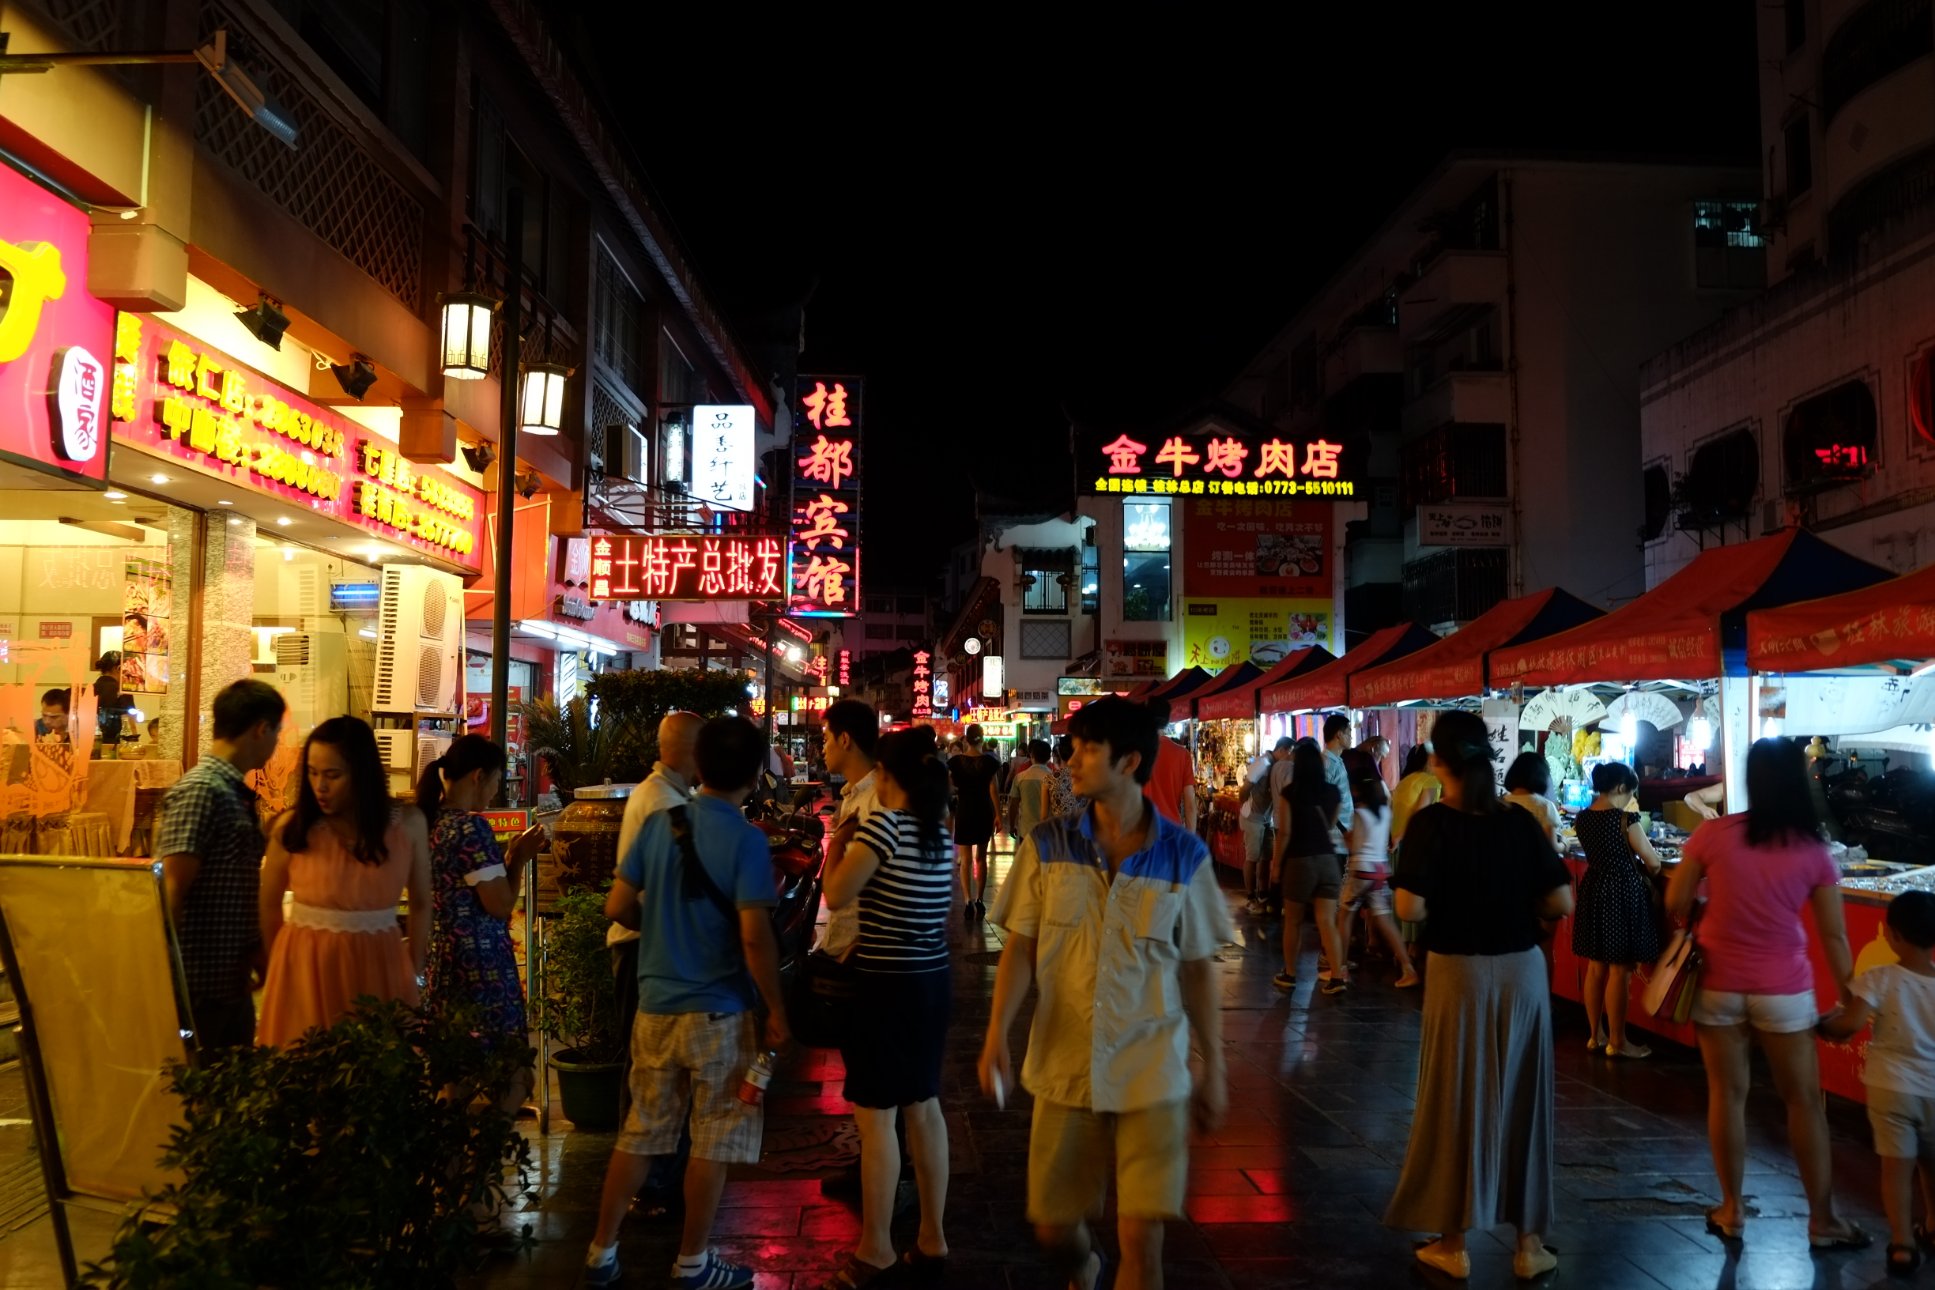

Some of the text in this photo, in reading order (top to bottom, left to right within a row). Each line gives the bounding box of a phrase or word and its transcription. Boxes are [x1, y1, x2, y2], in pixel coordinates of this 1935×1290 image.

[1102, 434, 1343, 479] 金牛烤肉店
[797, 382, 854, 606] 桂都宾馆
[1153, 478, 1204, 494] 桂林总店
[1195, 498, 1293, 517] 金牛烤肉店
[593, 538, 612, 597] 金顺昌
[613, 538, 781, 595] 土特产总批发
[913, 650, 931, 707] 金牛烤肉
